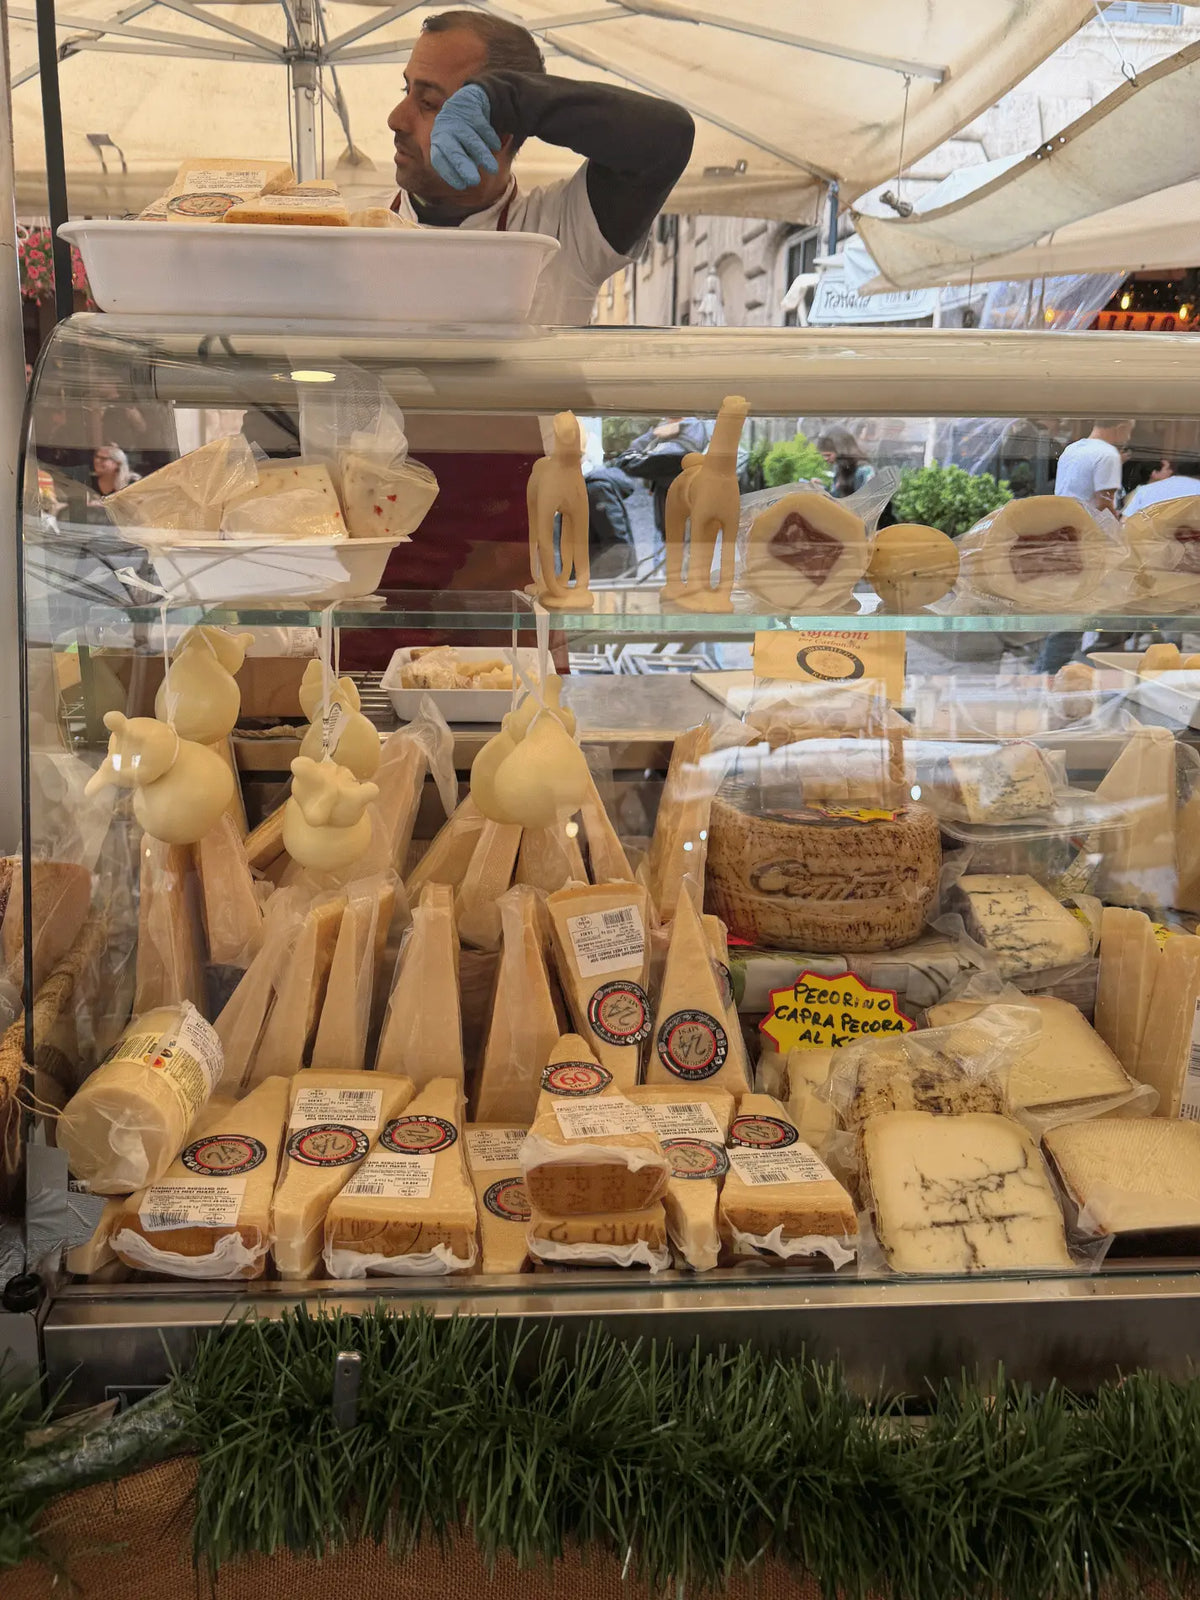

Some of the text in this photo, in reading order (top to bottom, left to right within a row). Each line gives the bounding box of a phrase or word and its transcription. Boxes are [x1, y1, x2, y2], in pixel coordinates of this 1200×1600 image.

[794, 983, 891, 1011] PECORINO
[775, 1005, 904, 1033] CAPRA PECORA
[679, 1034, 706, 1058] 24
[799, 1029, 823, 1044] AL
[560, 1071, 591, 1085] 60
[207, 1146, 241, 1164] 24
